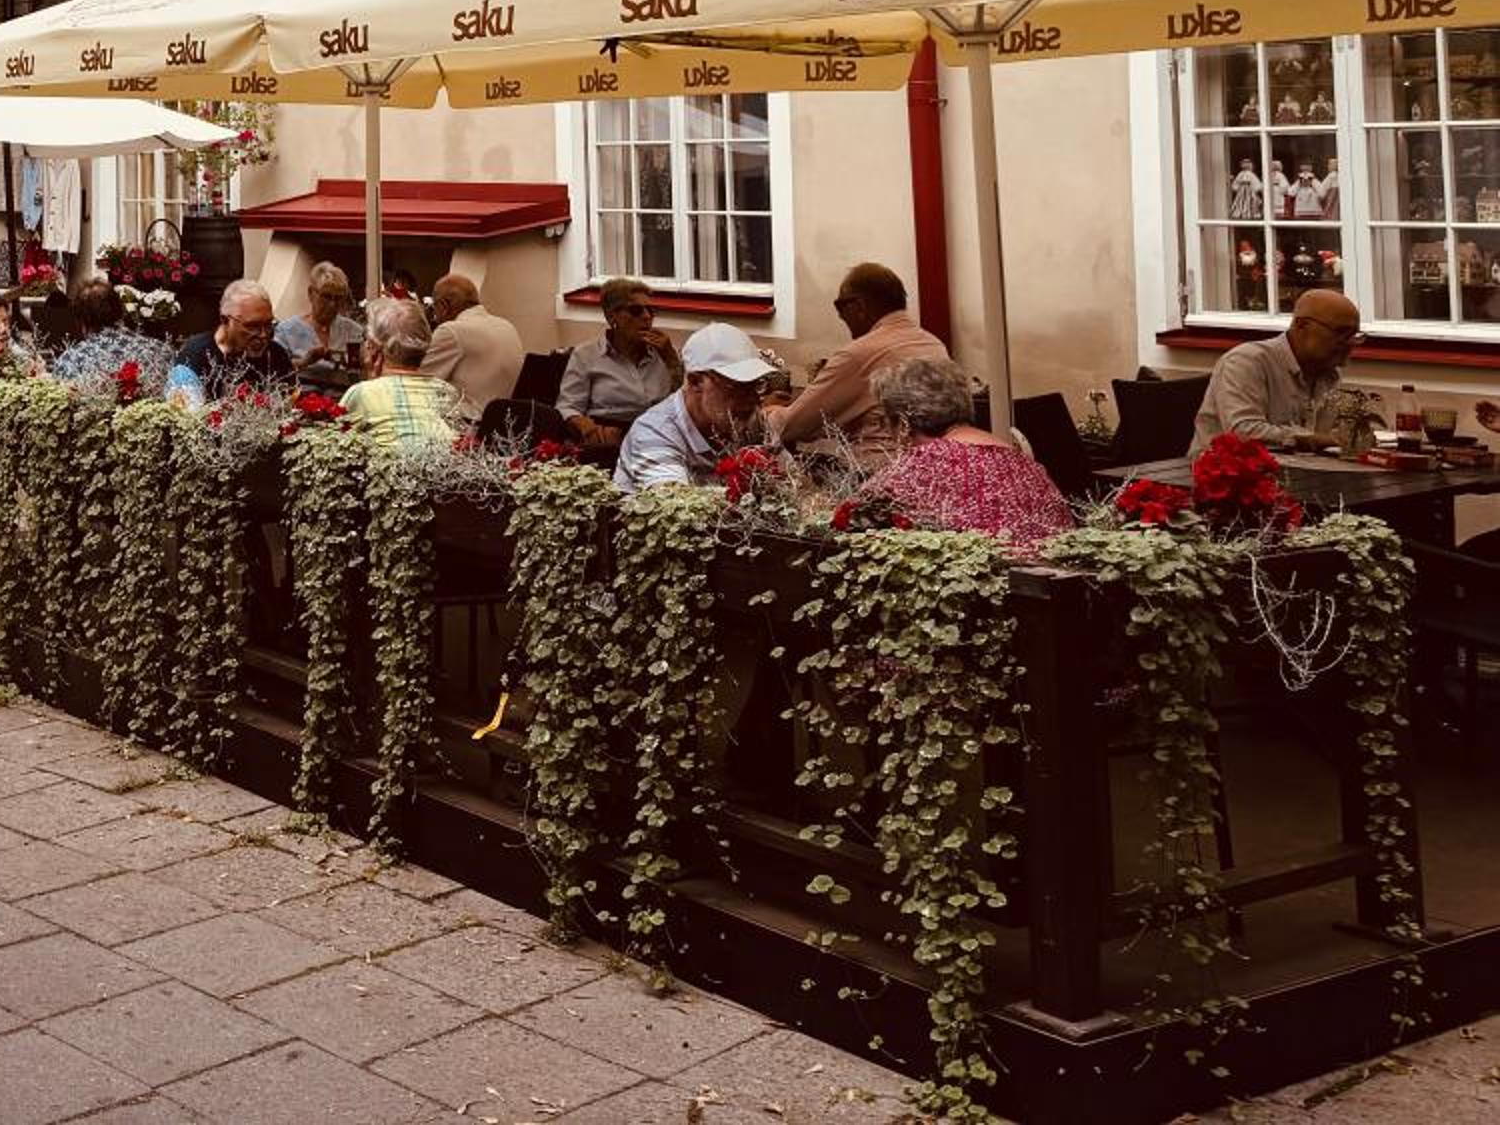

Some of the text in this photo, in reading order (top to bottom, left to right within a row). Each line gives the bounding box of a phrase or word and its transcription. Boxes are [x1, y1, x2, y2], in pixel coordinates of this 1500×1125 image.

[166, 32, 207, 66] saku
[320, 19, 369, 58] saku
[6, 50, 35, 78] saku
[80, 41, 114, 72] saku
